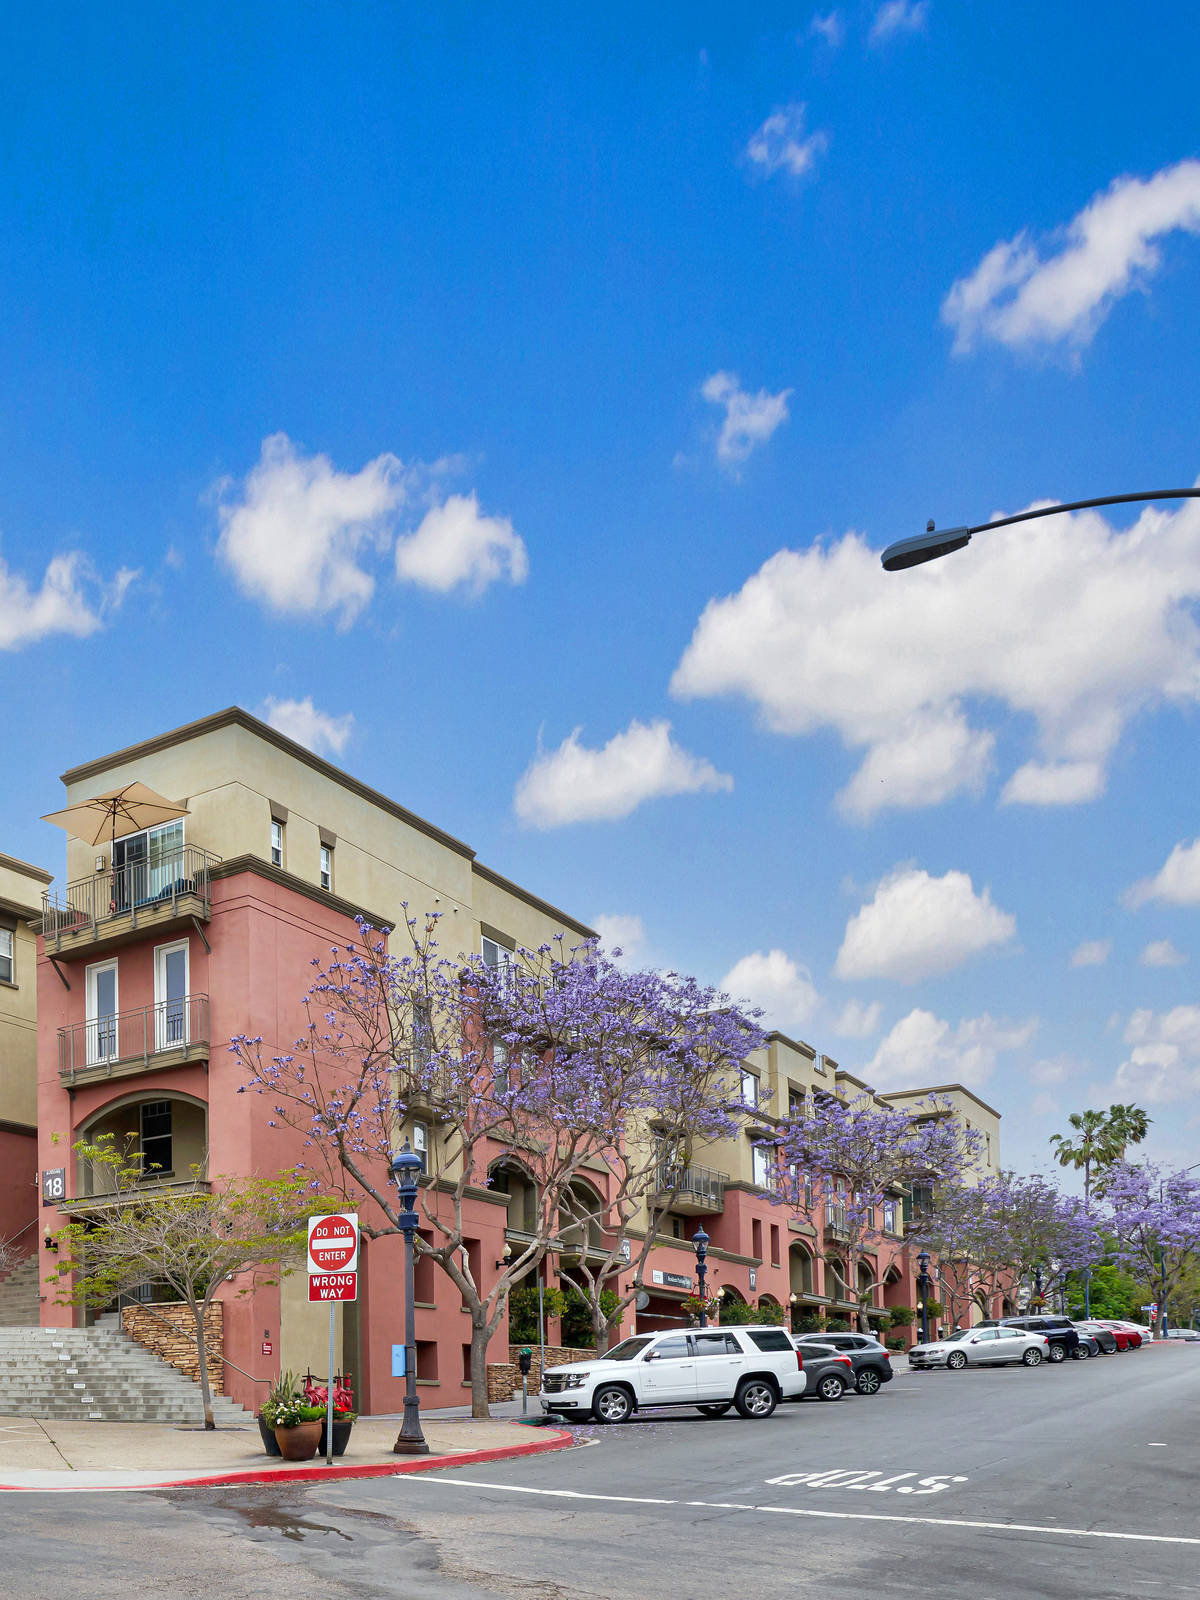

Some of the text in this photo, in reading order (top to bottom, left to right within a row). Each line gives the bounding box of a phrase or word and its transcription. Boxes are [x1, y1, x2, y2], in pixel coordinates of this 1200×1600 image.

[45, 1178, 62, 1196] 18
[316, 1226, 350, 1237] DO NOT
[319, 1251, 346, 1261] ENTER
[312, 1275, 353, 1287] WRONG
[320, 1288, 344, 1299] WAY
[764, 1469, 969, 1494] STOP
